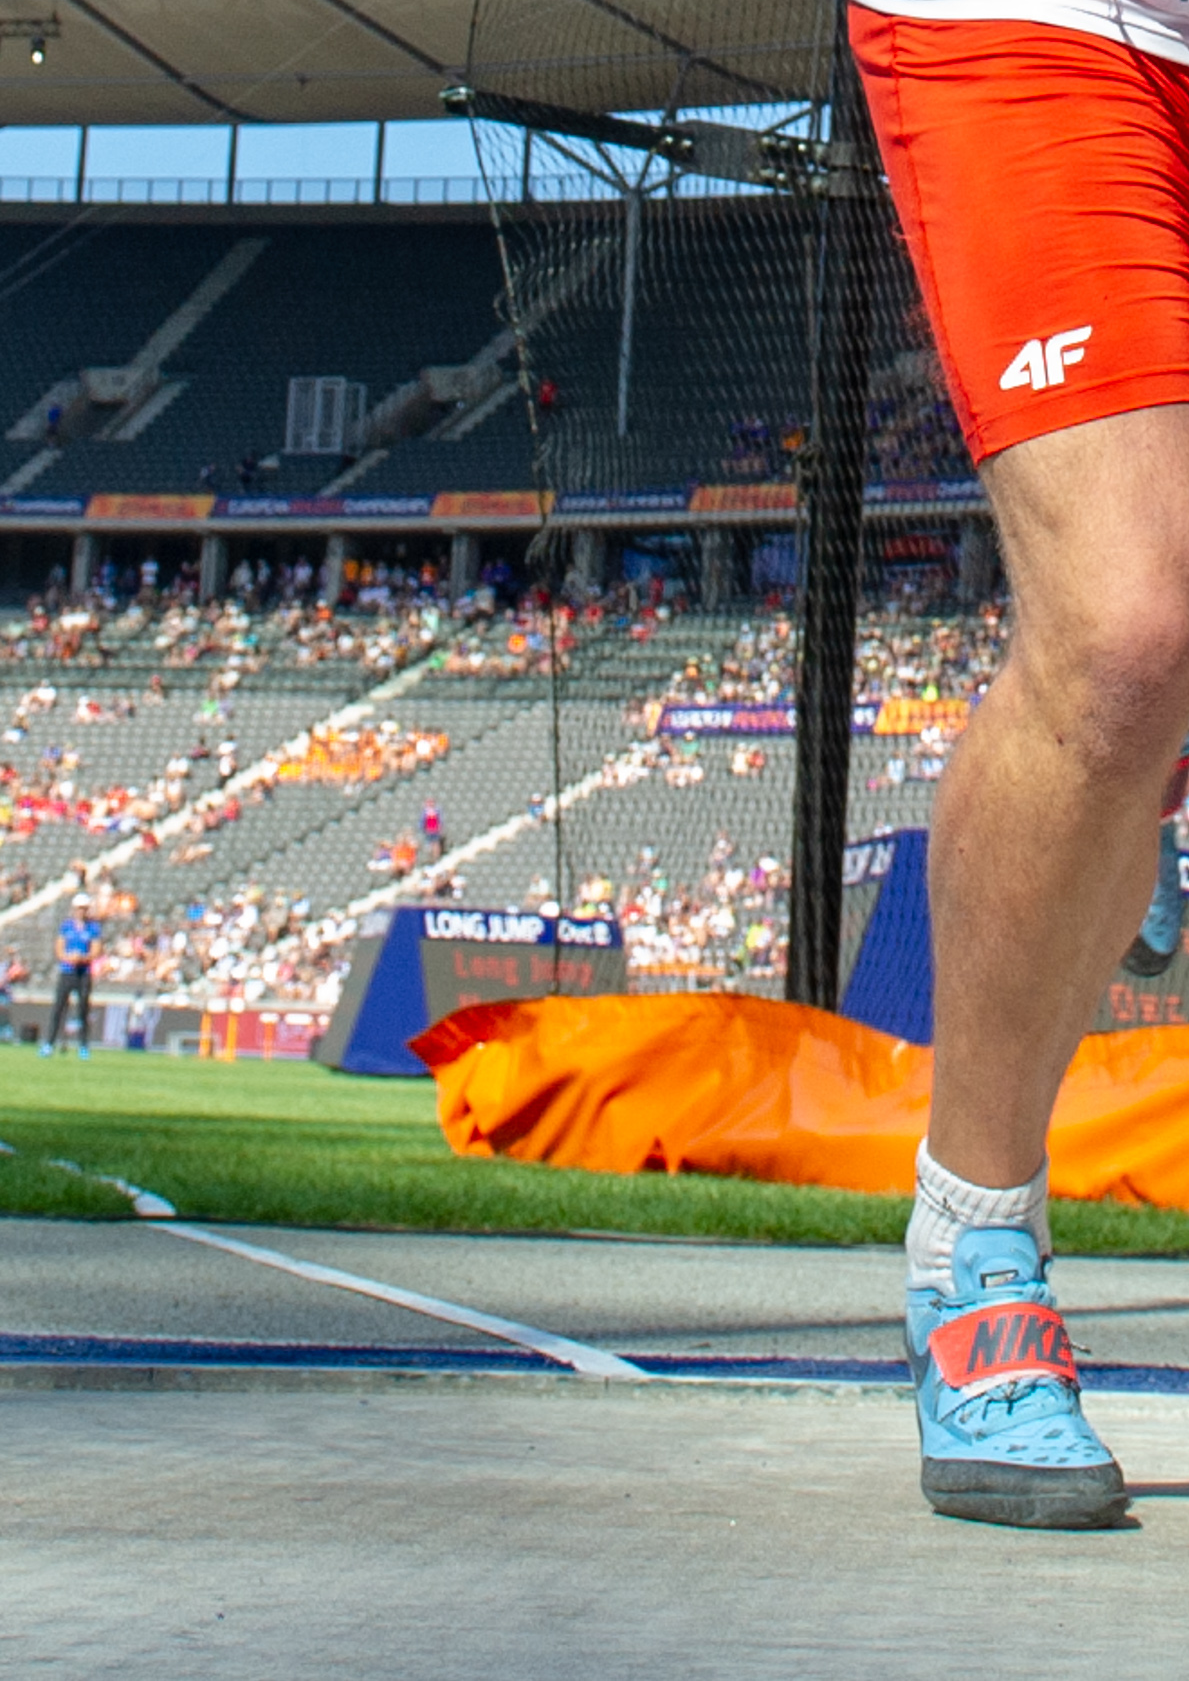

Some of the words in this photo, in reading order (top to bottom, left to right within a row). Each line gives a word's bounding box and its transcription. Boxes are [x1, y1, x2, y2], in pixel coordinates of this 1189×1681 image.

[999, 325, 1093, 390] 4F
[425, 910, 487, 942] LONG
[488, 913, 546, 943] JUMP
[966, 1314, 1069, 1374] NIKE
